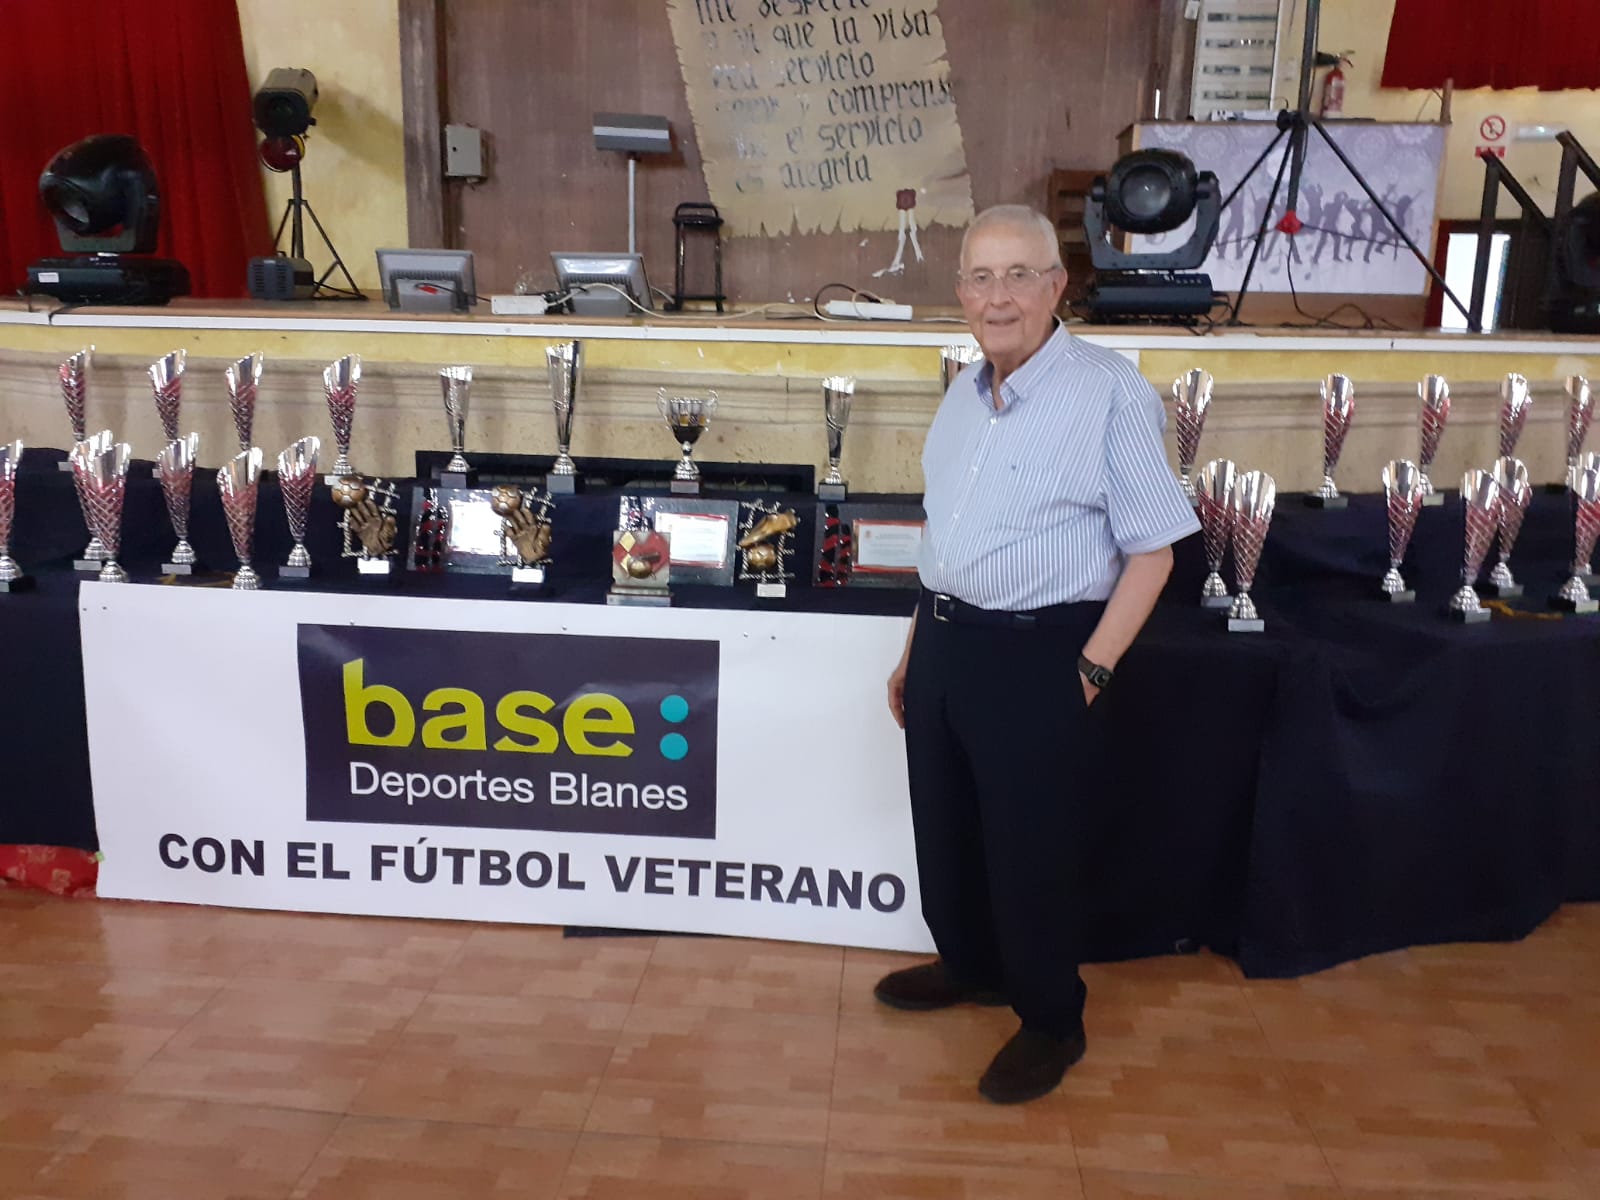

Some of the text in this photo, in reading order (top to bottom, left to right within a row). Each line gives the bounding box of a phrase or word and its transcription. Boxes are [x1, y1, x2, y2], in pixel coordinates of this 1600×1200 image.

[773, 21, 815, 50] que
[832, 16, 860, 46] la
[873, 8, 931, 41] vida
[818, 115, 924, 152] servicio
[349, 761, 689, 812] Deportes Blanes
[159, 834, 906, 913] CON EL FÚTBOL VETERANO
